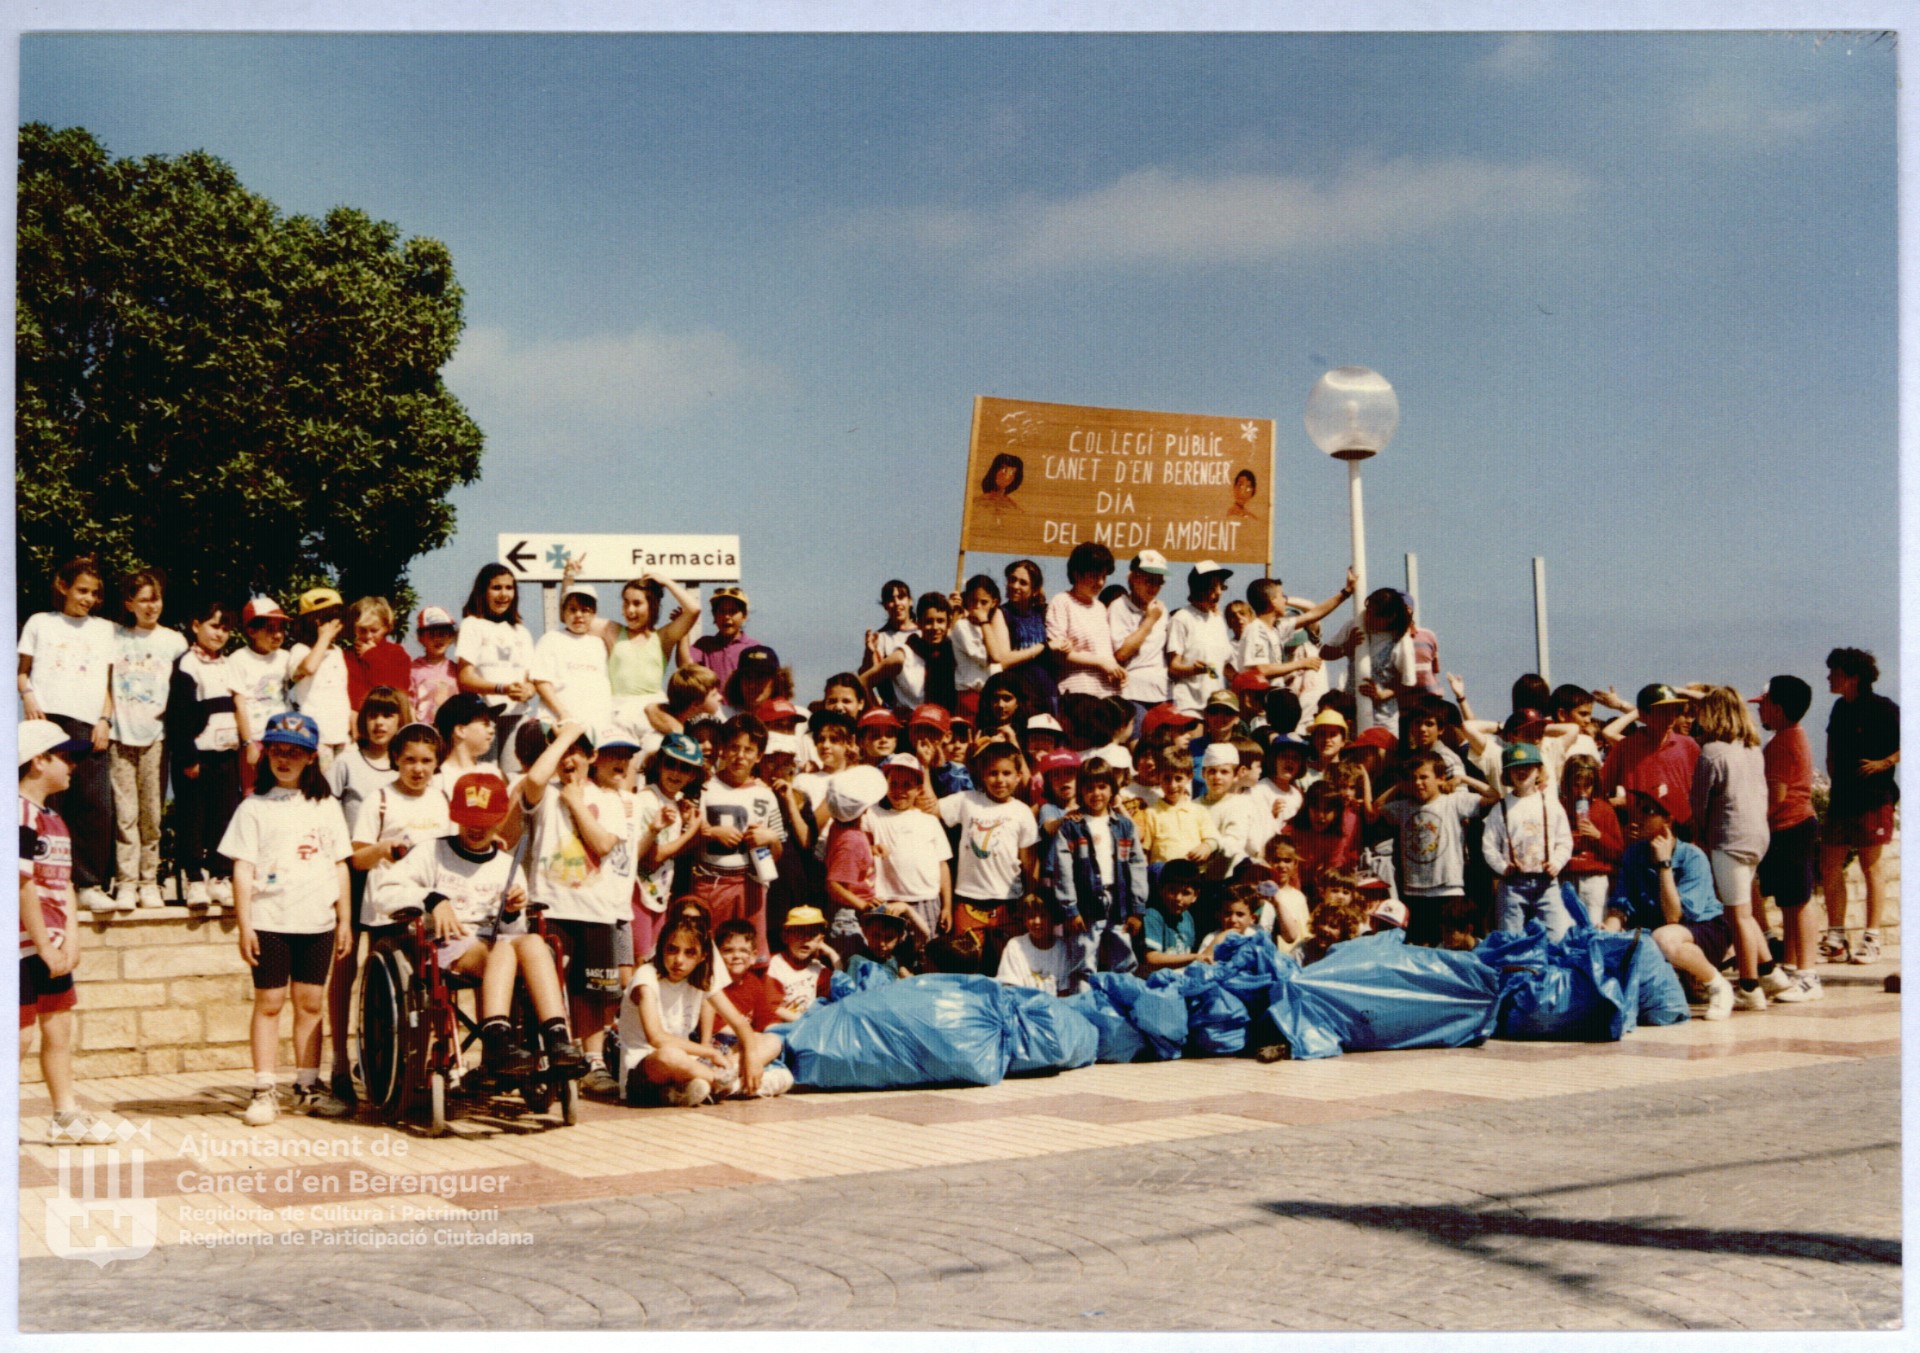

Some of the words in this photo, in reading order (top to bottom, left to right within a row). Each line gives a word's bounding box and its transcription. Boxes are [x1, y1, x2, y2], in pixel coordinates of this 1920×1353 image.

[1114, 460, 1153, 484] D'EN
[1043, 520, 1082, 545] DEL
[1094, 516, 1151, 548] MEDI
[1162, 515, 1242, 551] AMBIENT
[632, 549, 736, 566] Farmacia
[753, 798, 769, 817] 5
